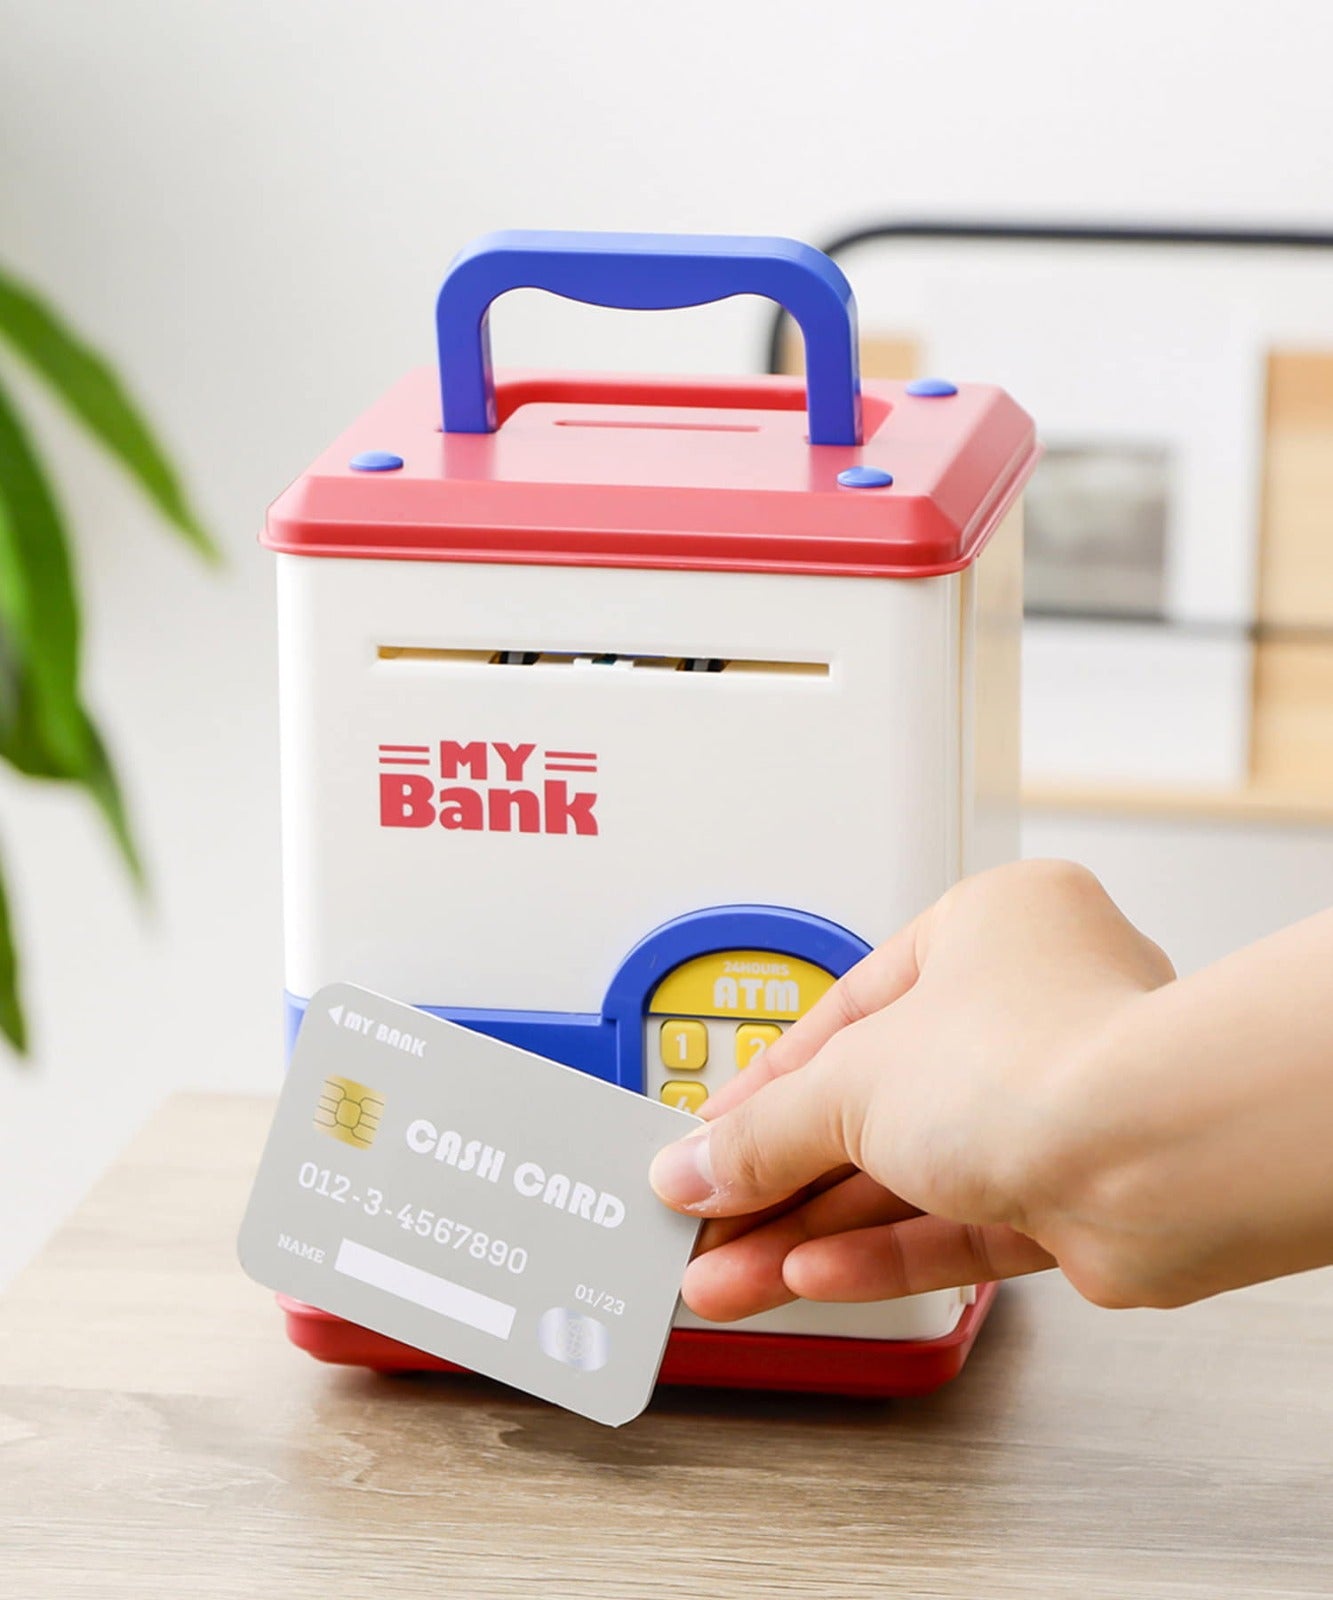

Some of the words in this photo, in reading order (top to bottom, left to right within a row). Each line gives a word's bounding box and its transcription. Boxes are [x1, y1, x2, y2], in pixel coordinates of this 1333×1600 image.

[440, 740, 537, 782] MY
[379, 773, 599, 836] Bank
[723, 961, 789, 976] 24HOURS
[713, 976, 799, 1012] ATM
[344, 1011, 375, 1035] MY
[376, 1023, 427, 1058] BANK
[676, 1032, 687, 1061] 1
[406, 1119, 506, 1184] CASH
[513, 1162, 626, 1229] CARD
[298, 1161, 528, 1275] 012-3-4567890
[277, 1233, 326, 1264] NAME
[575, 1284, 625, 1316] 01/23
